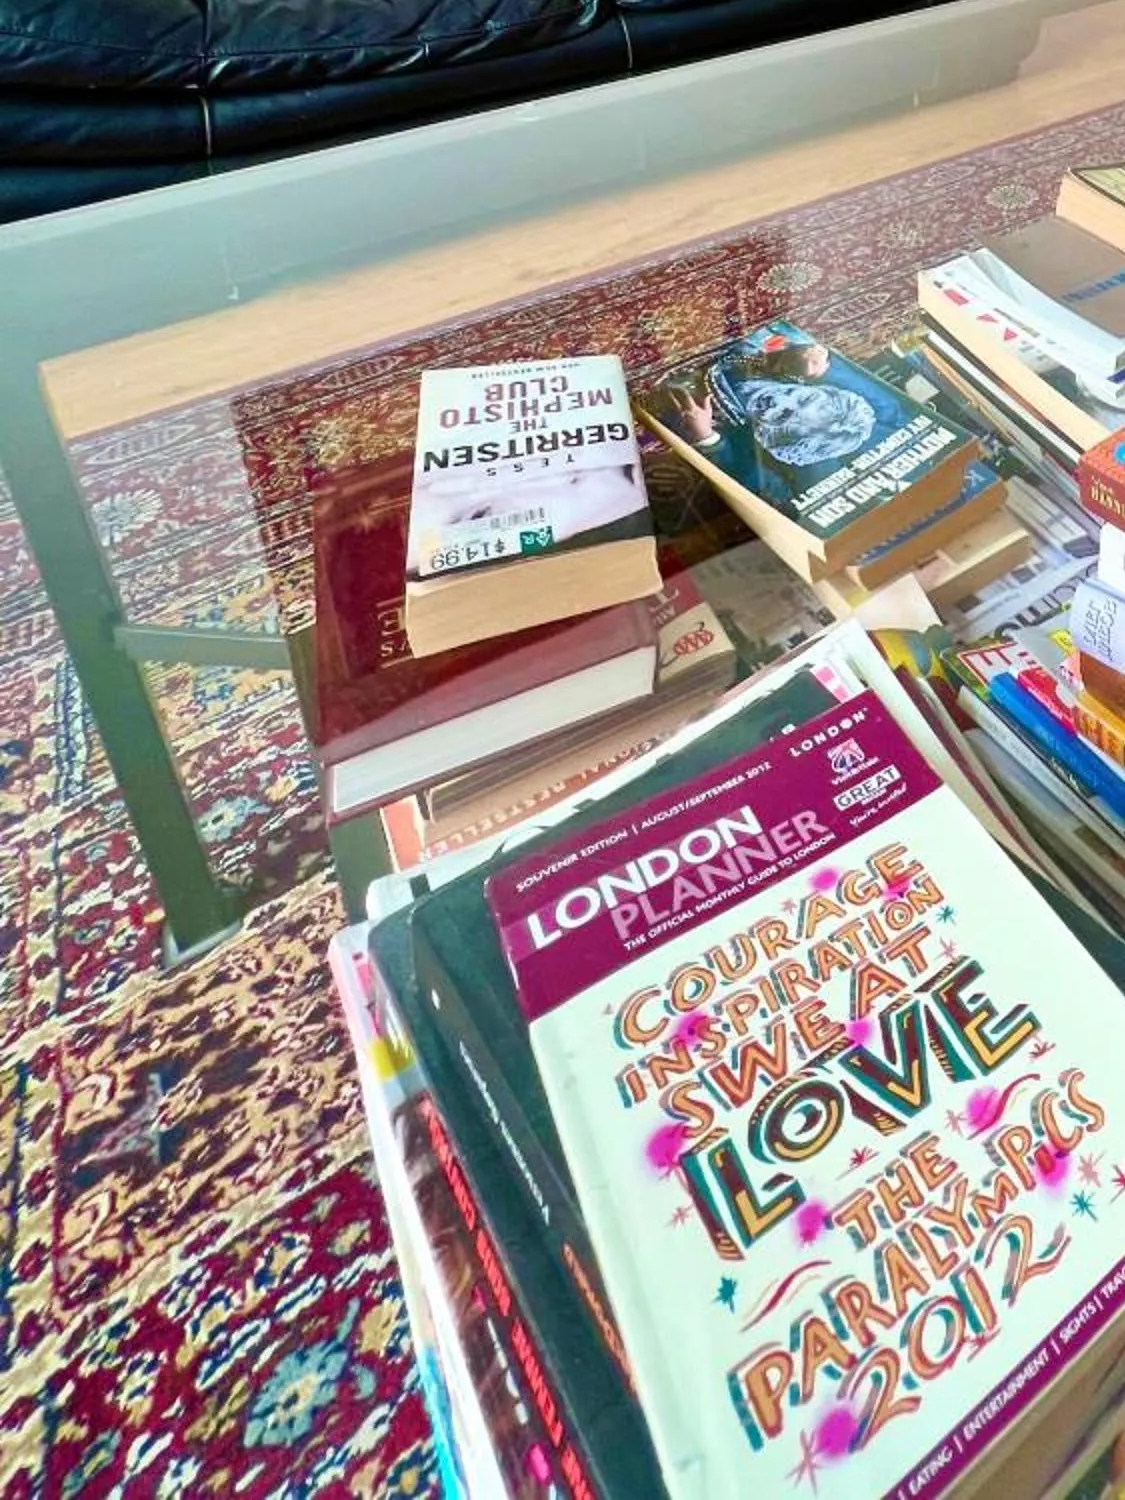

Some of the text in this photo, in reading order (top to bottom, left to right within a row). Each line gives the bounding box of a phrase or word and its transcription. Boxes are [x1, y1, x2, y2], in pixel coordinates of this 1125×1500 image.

[423, 422, 630, 473] GERRITSEN
[440, 387, 614, 429] MEPHISTO
[484, 375, 569, 402] CLUB
[511, 417, 548, 433] THE
[431, 537, 506, 571] $14.99
[808, 494, 856, 529] SON
[788, 707, 867, 757] LONDON
[837, 768, 897, 807] GREAT
[516, 760, 773, 893] SOUVENIR EDITION AUGUST/SEPTEMBER 2012
[527, 805, 764, 950] LONDON
[610, 809, 830, 941] PLANNER
[613, 842, 924, 1050] COURAGE
[623, 831, 836, 953] THE OFFICIAL MONTHLY GUIDE TO LONDON
[615, 873, 945, 1109] INSPIRATION
[660, 923, 932, 1139] SWEAT
[679, 955, 1043, 1262] LOVE
[823, 1130, 960, 1252] THE
[836, 1212, 1072, 1454] 2012
[907, 1446, 954, 1496] EATING
[962, 1347, 1051, 1442] ENTERTAINMENT
[1058, 1301, 1098, 1345] SIGHTS
